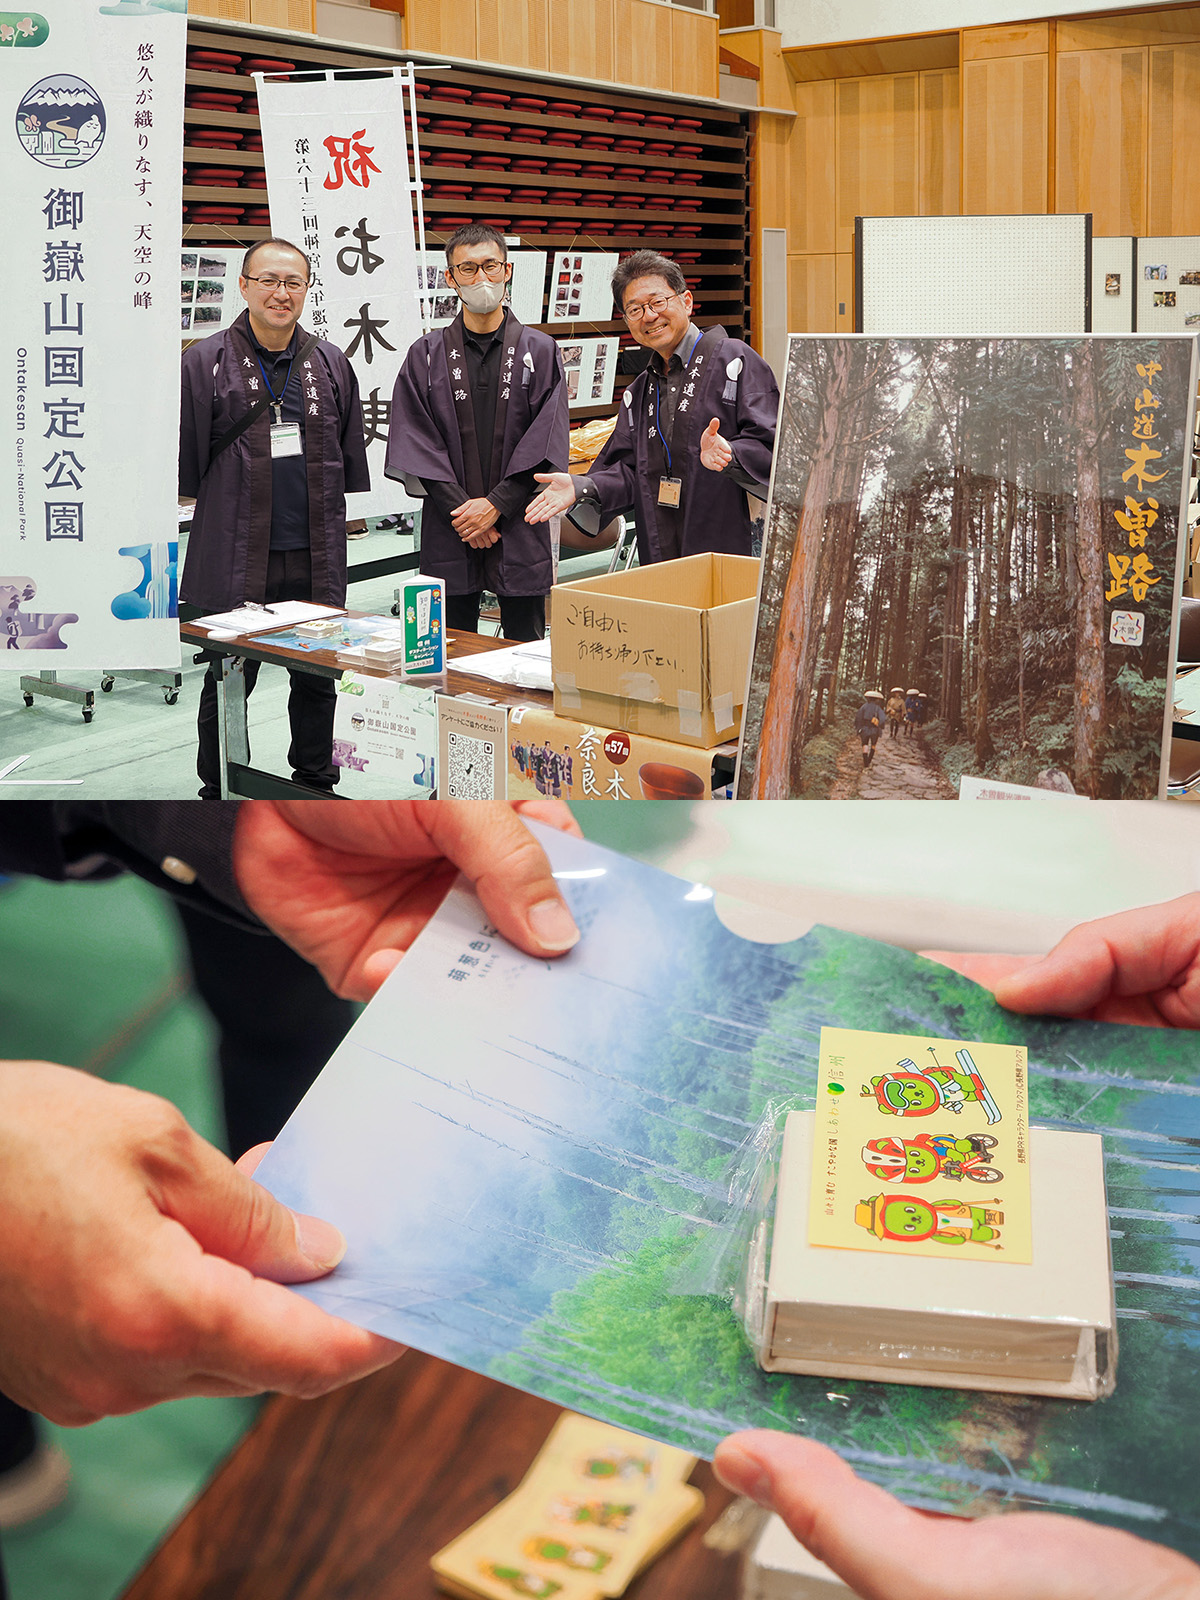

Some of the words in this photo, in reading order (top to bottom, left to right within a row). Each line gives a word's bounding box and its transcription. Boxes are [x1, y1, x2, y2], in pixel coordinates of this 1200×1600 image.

[133, 42, 154, 310] 悠久が織りなす、天空の峰
[16, 347, 28, 431] Ontakesan
[41, 187, 87, 542] 御嶽山国定公園
[303, 360, 320, 416] 日本遺産
[500, 346, 516, 400] 日本遺産
[677, 355, 704, 413] 日本遺産
[16, 437, 26, 516] Quasi-National
[18, 518, 27, 541] Park
[566, 603, 628, 633] ご自由に
[575, 726, 602, 800] 奈良
